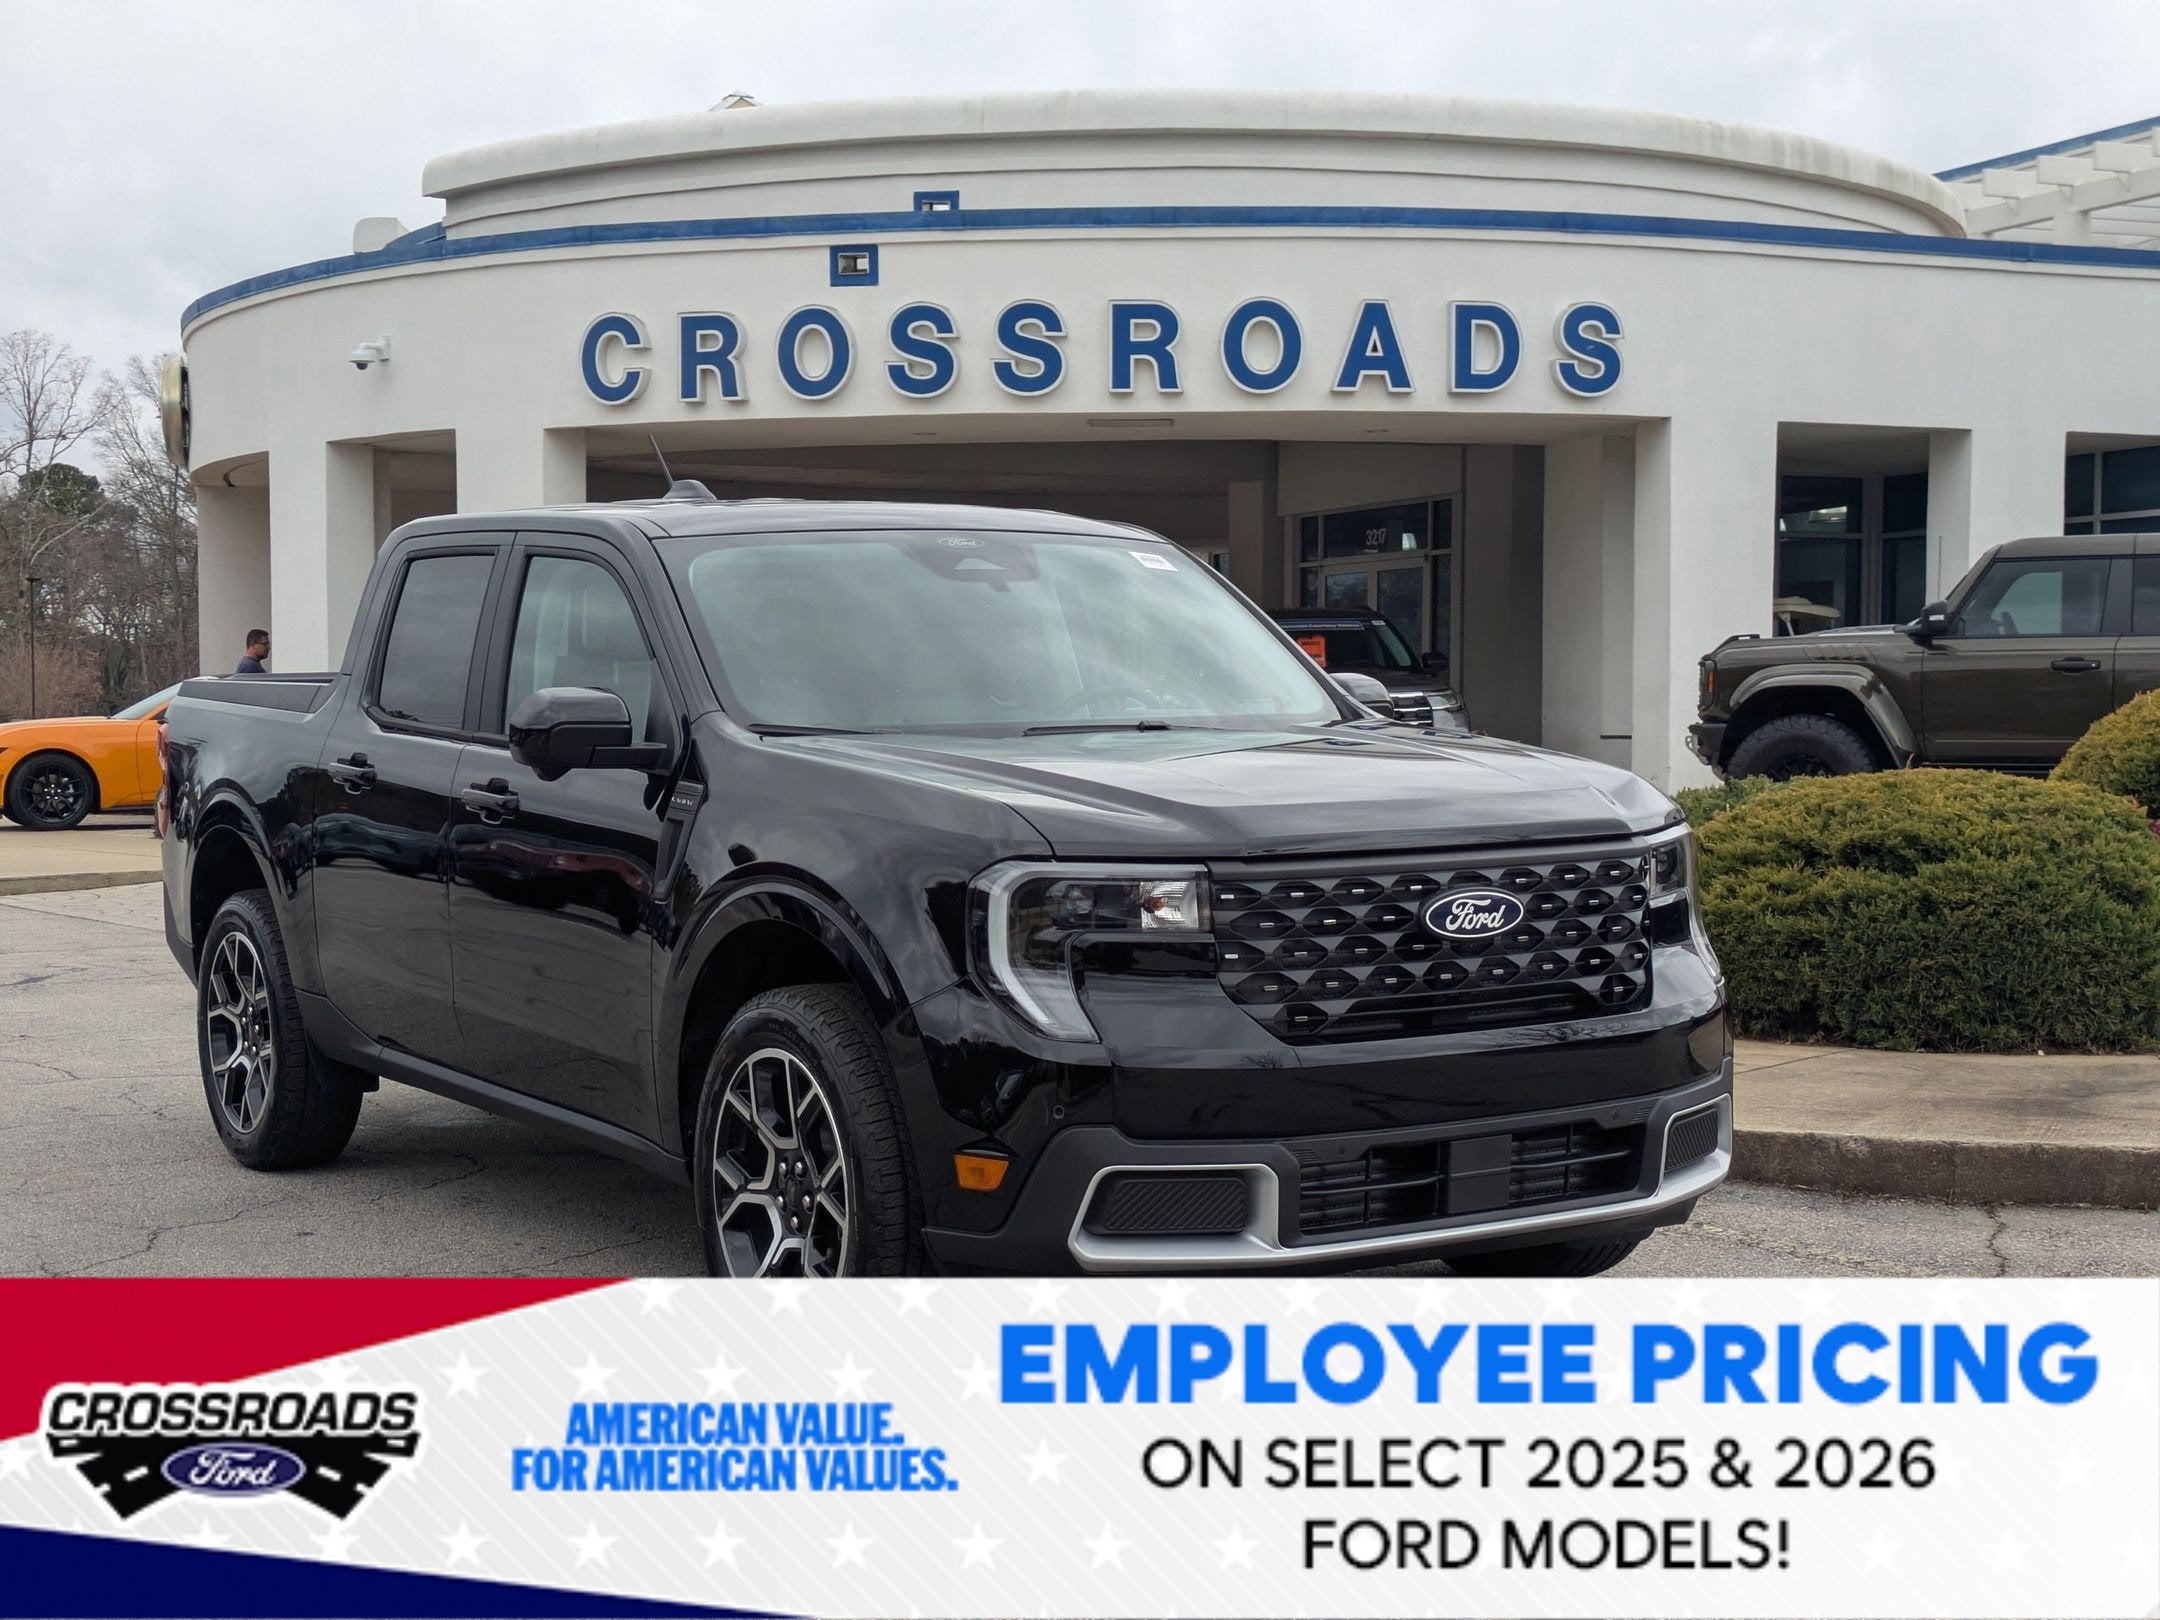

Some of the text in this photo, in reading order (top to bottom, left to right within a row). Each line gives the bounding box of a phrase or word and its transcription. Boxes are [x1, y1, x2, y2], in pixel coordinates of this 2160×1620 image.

[579, 296, 1625, 406] CROSSROADS
[1366, 528, 1387, 545] 3217
[1445, 898, 1506, 931] Ford
